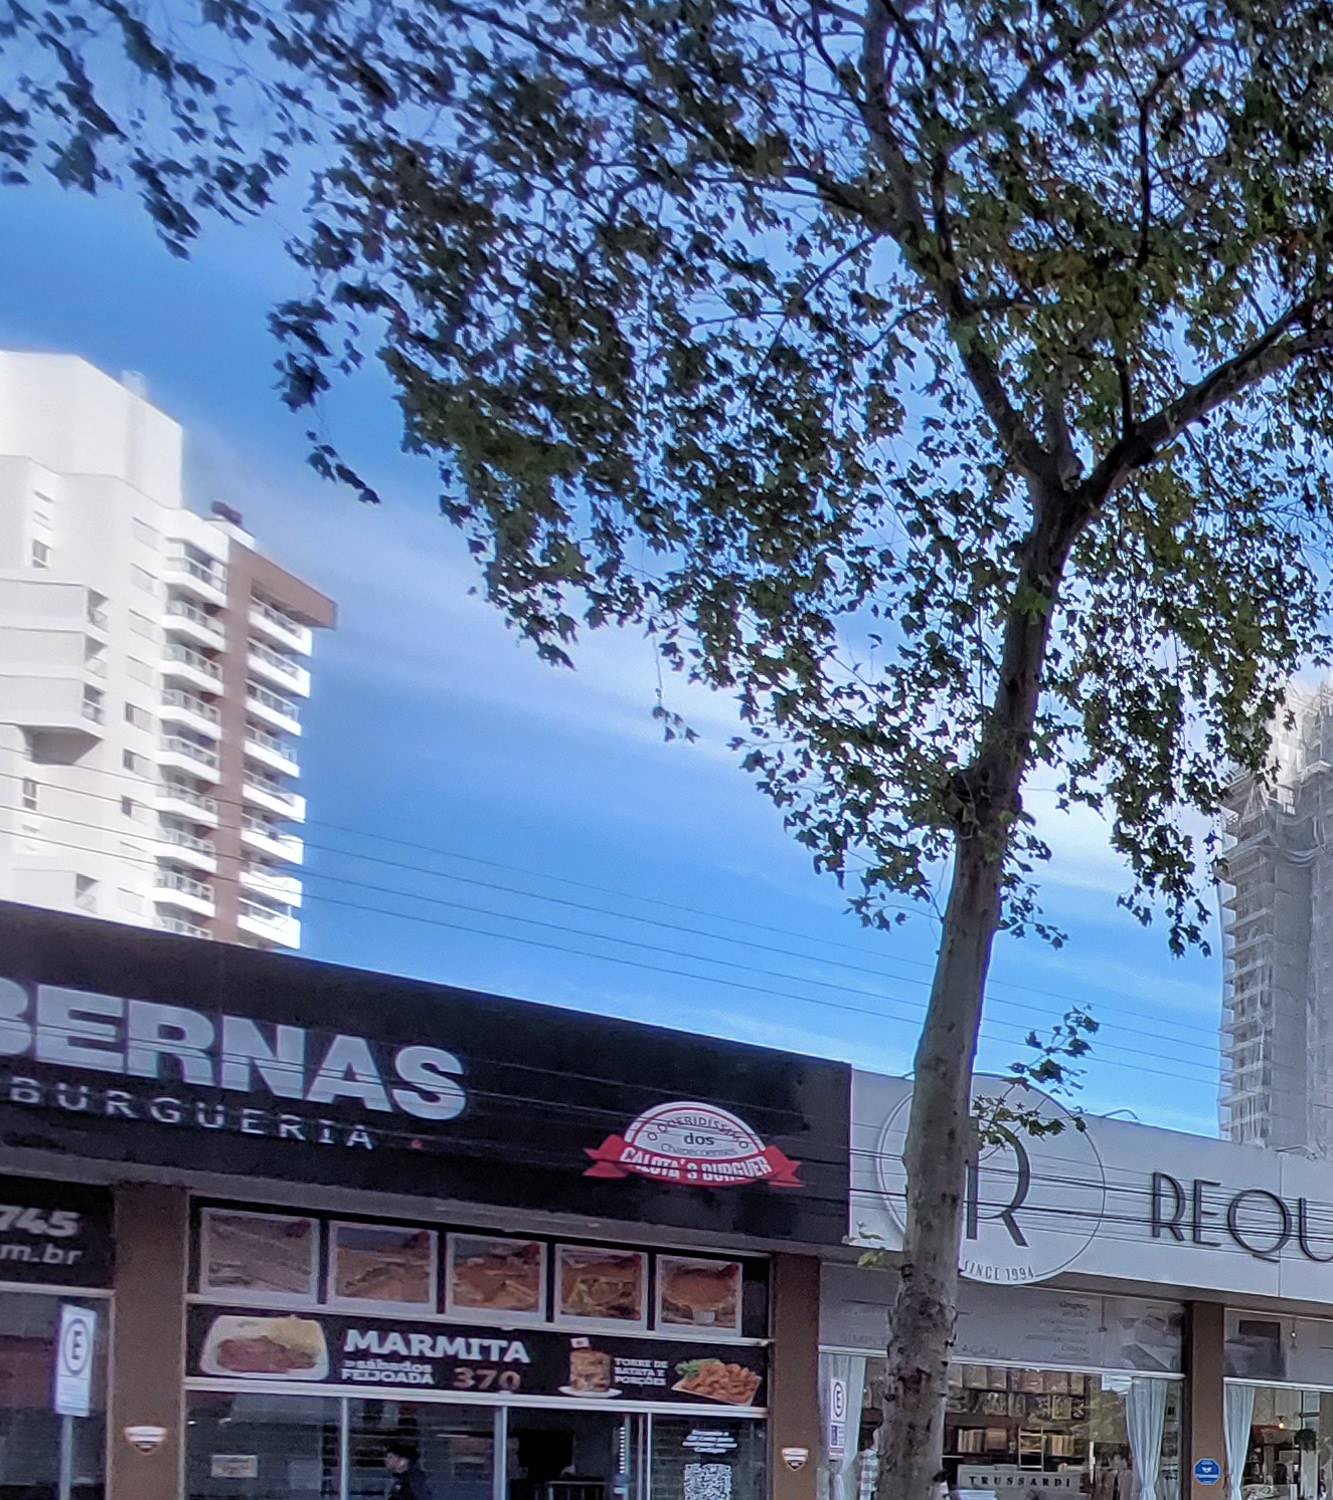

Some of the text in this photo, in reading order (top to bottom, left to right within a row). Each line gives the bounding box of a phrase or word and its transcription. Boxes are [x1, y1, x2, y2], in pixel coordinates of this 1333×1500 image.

[9, 1076, 374, 1150] BURGUERIA
[684, 1132, 715, 1147] dos
[1005, 1263, 1036, 1281] 1994
[71, 1331, 83, 1360] E
[344, 1329, 530, 1363] MARMITA
[341, 1369, 434, 1385] FEIJOADA
[453, 1366, 521, 1390] 370
[968, 1475, 1070, 1488] TRUSSARDI
